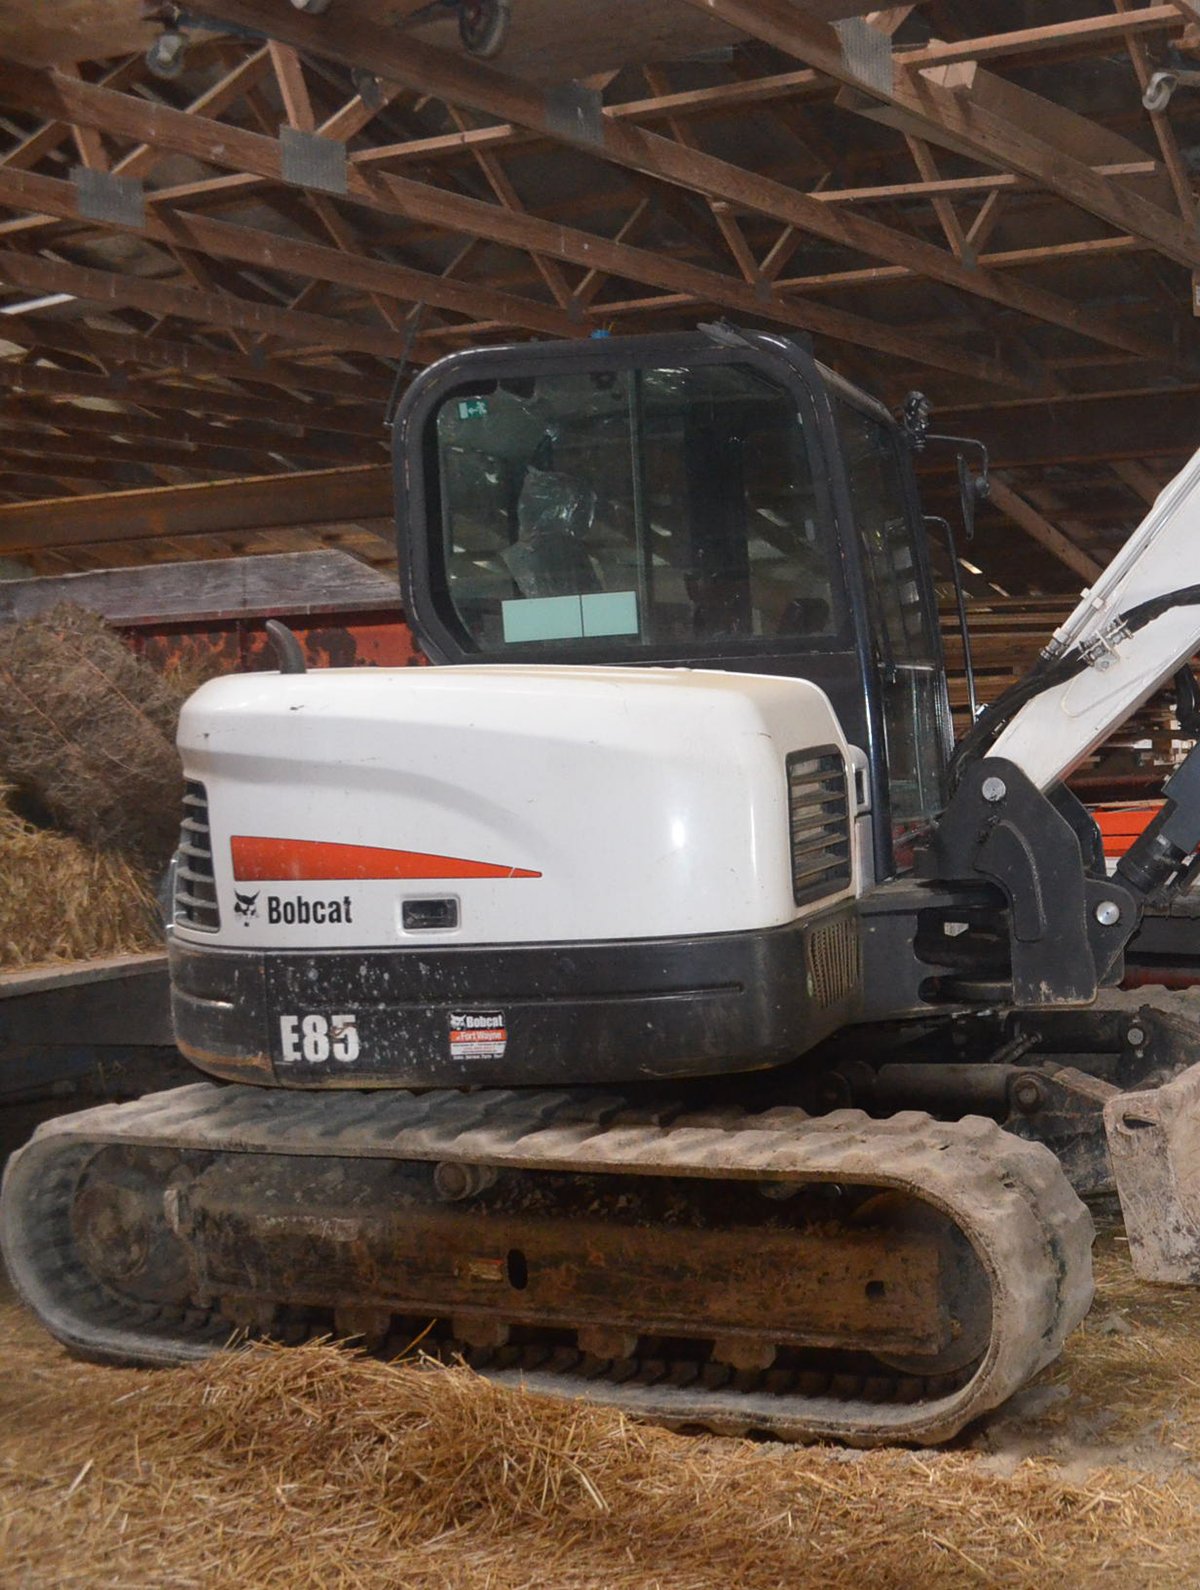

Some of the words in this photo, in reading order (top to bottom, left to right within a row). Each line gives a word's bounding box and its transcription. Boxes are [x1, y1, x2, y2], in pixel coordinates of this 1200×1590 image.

[267, 895, 353, 925] Bobcat
[466, 1014, 503, 1028] Bobcat
[279, 1014, 360, 1063] E85
